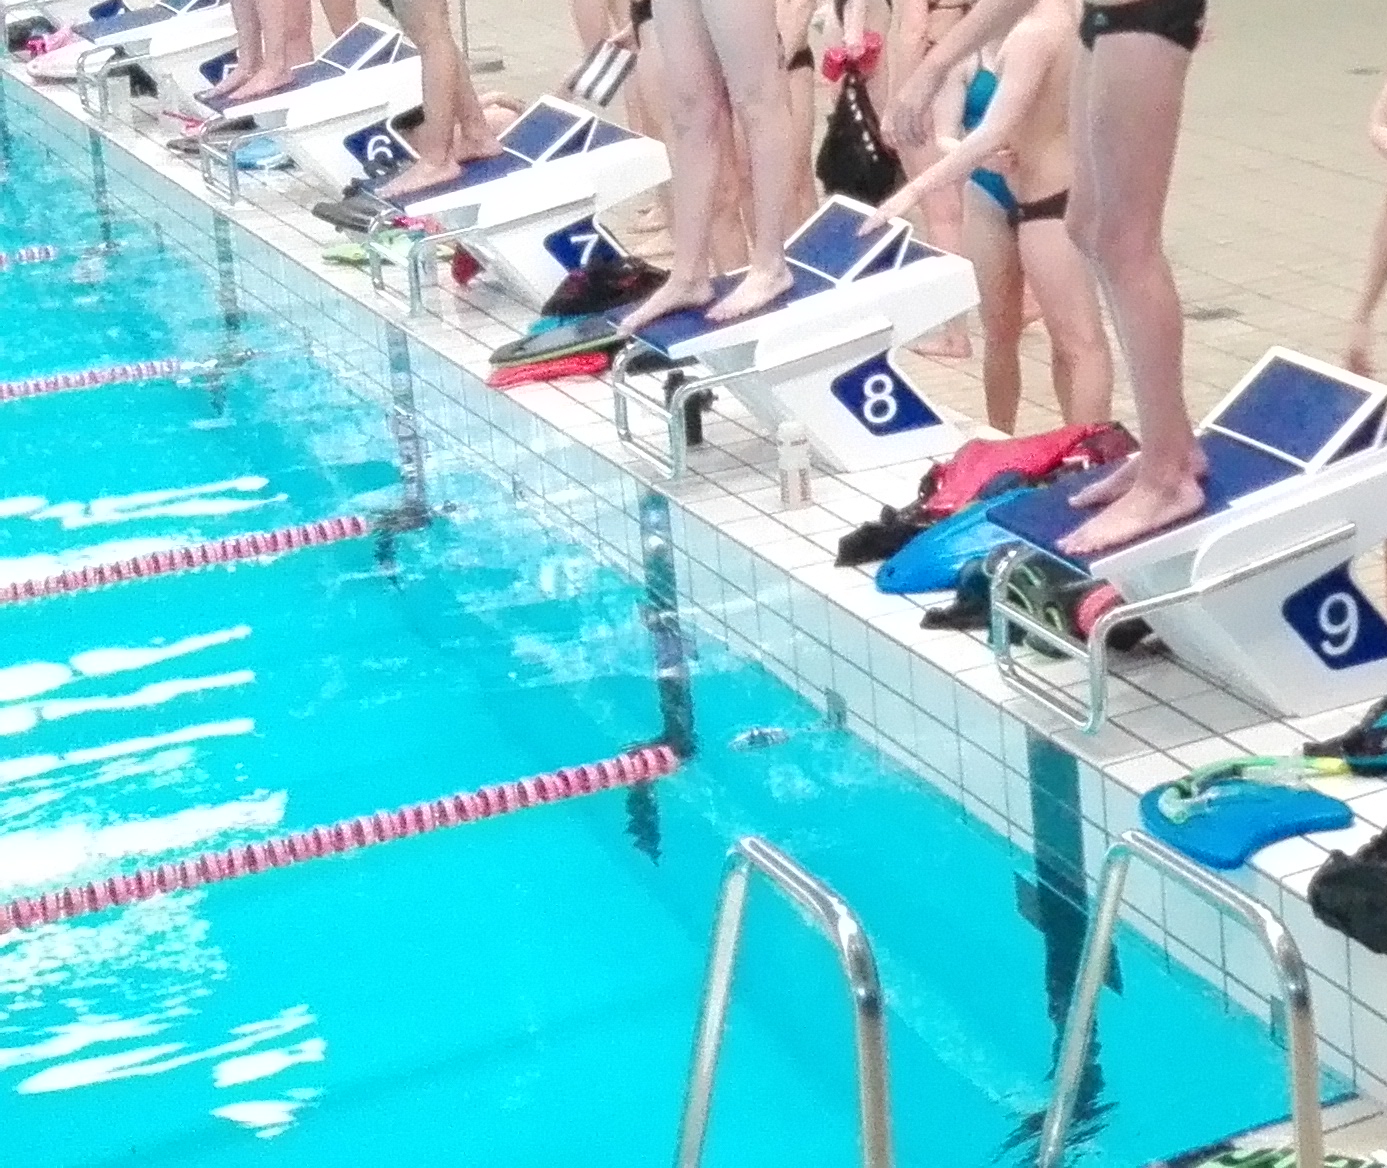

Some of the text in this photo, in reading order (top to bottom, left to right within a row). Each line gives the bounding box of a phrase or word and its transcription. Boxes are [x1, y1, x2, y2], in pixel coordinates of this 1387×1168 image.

[367, 134, 394, 161] 6
[570, 233, 599, 266] 7
[862, 373, 898, 424] 8
[1318, 591, 1361, 657] 9
